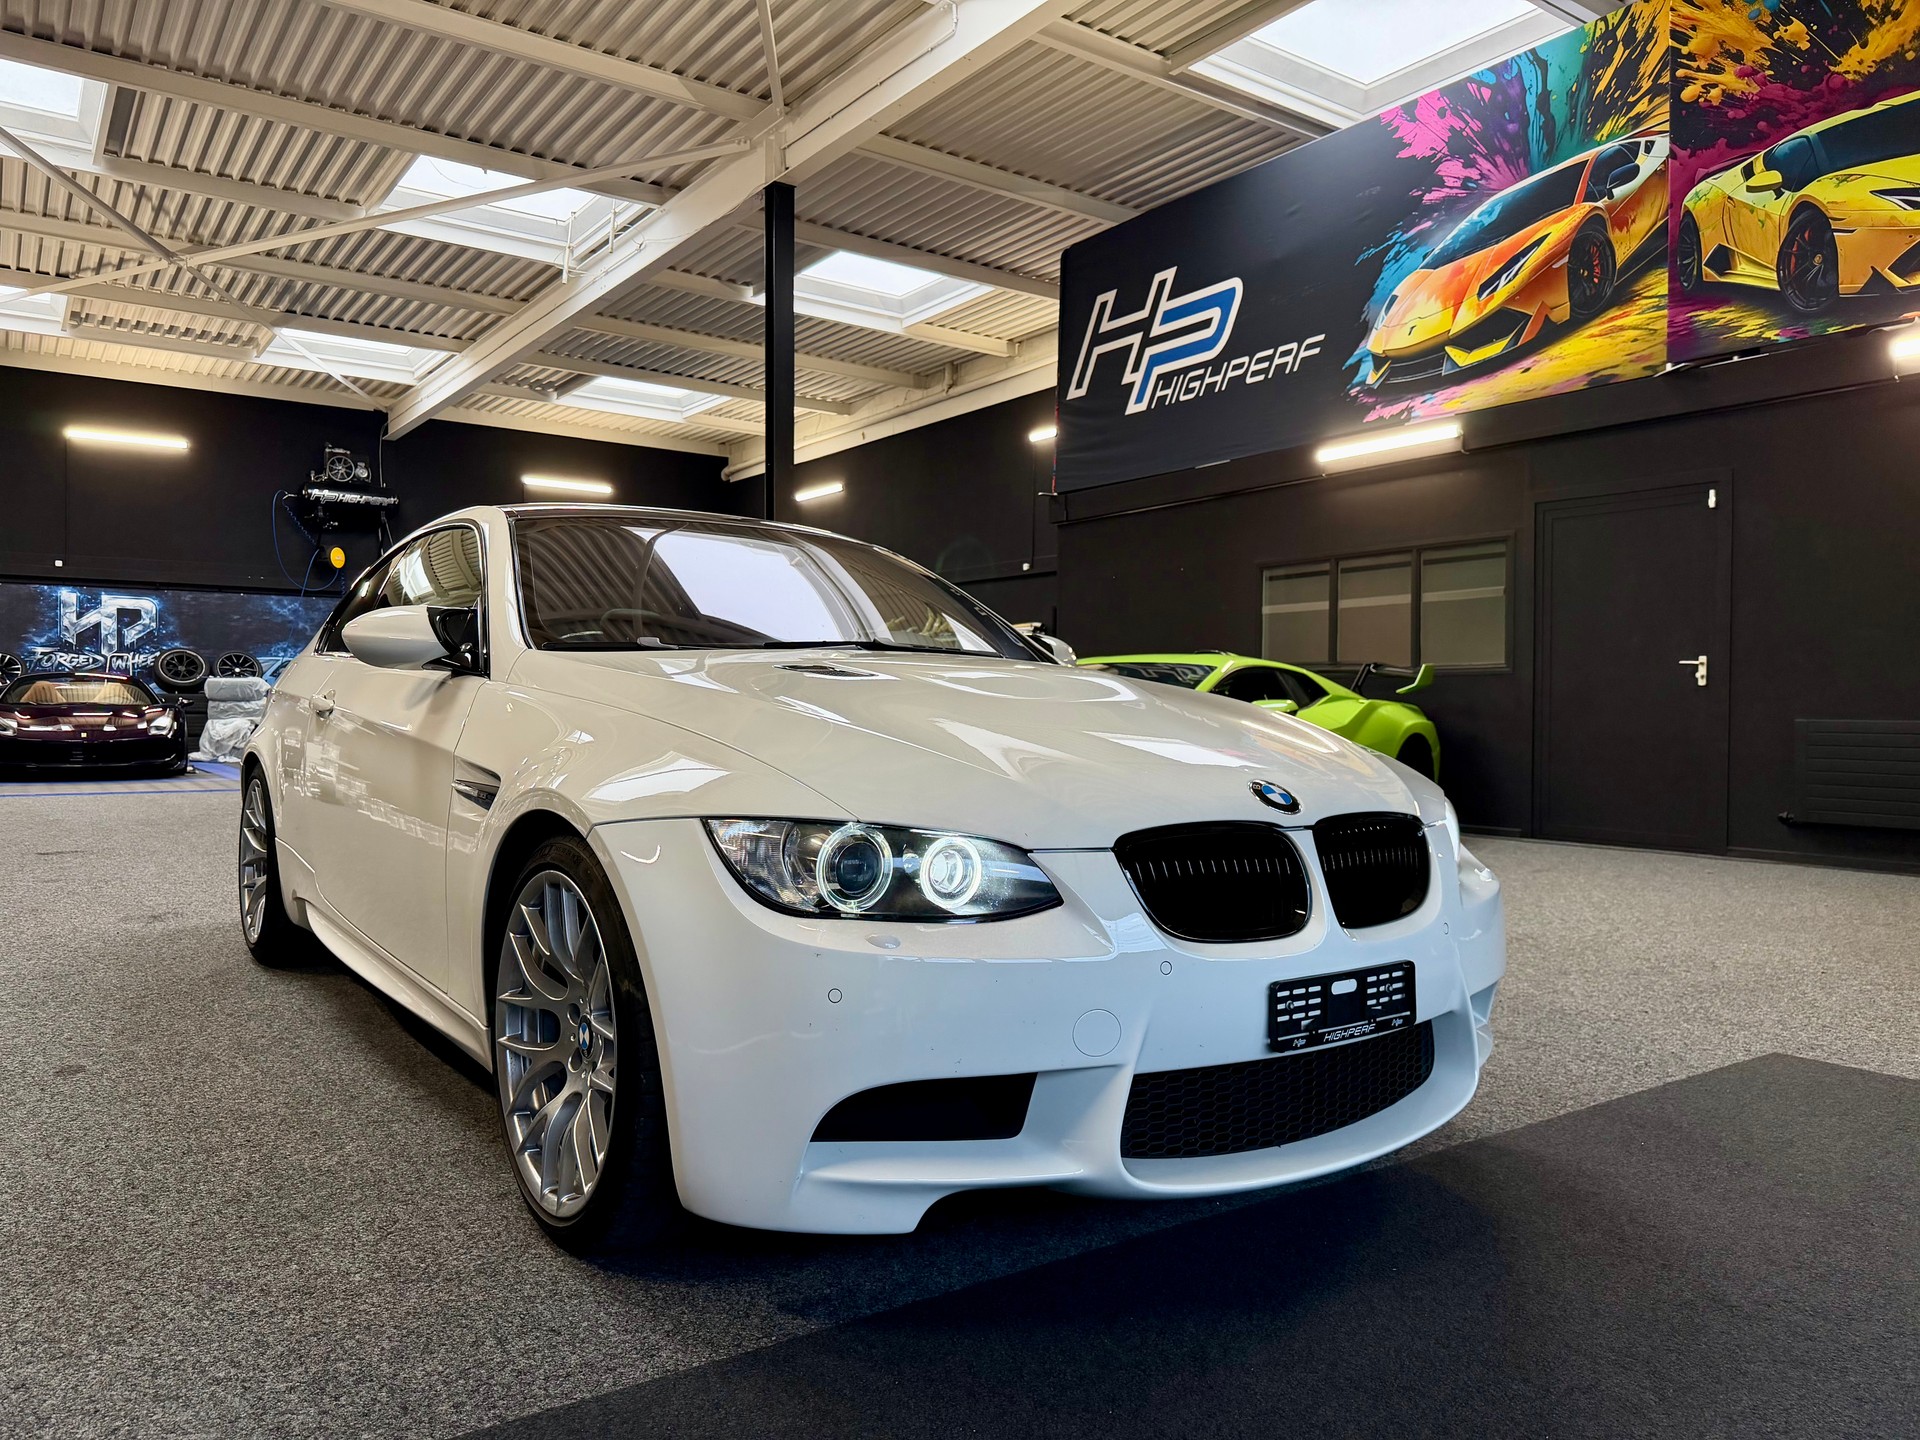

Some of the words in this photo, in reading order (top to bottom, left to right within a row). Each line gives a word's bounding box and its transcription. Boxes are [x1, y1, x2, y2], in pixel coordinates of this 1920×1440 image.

[1065, 265, 1244, 416] HP
[1151, 333, 1326, 409] HIGHPERF
[57, 589, 160, 655] HP
[29, 646, 106, 672] FORGED
[111, 651, 160, 670] WHEE
[1323, 1023, 1376, 1042] HIGHPERF
